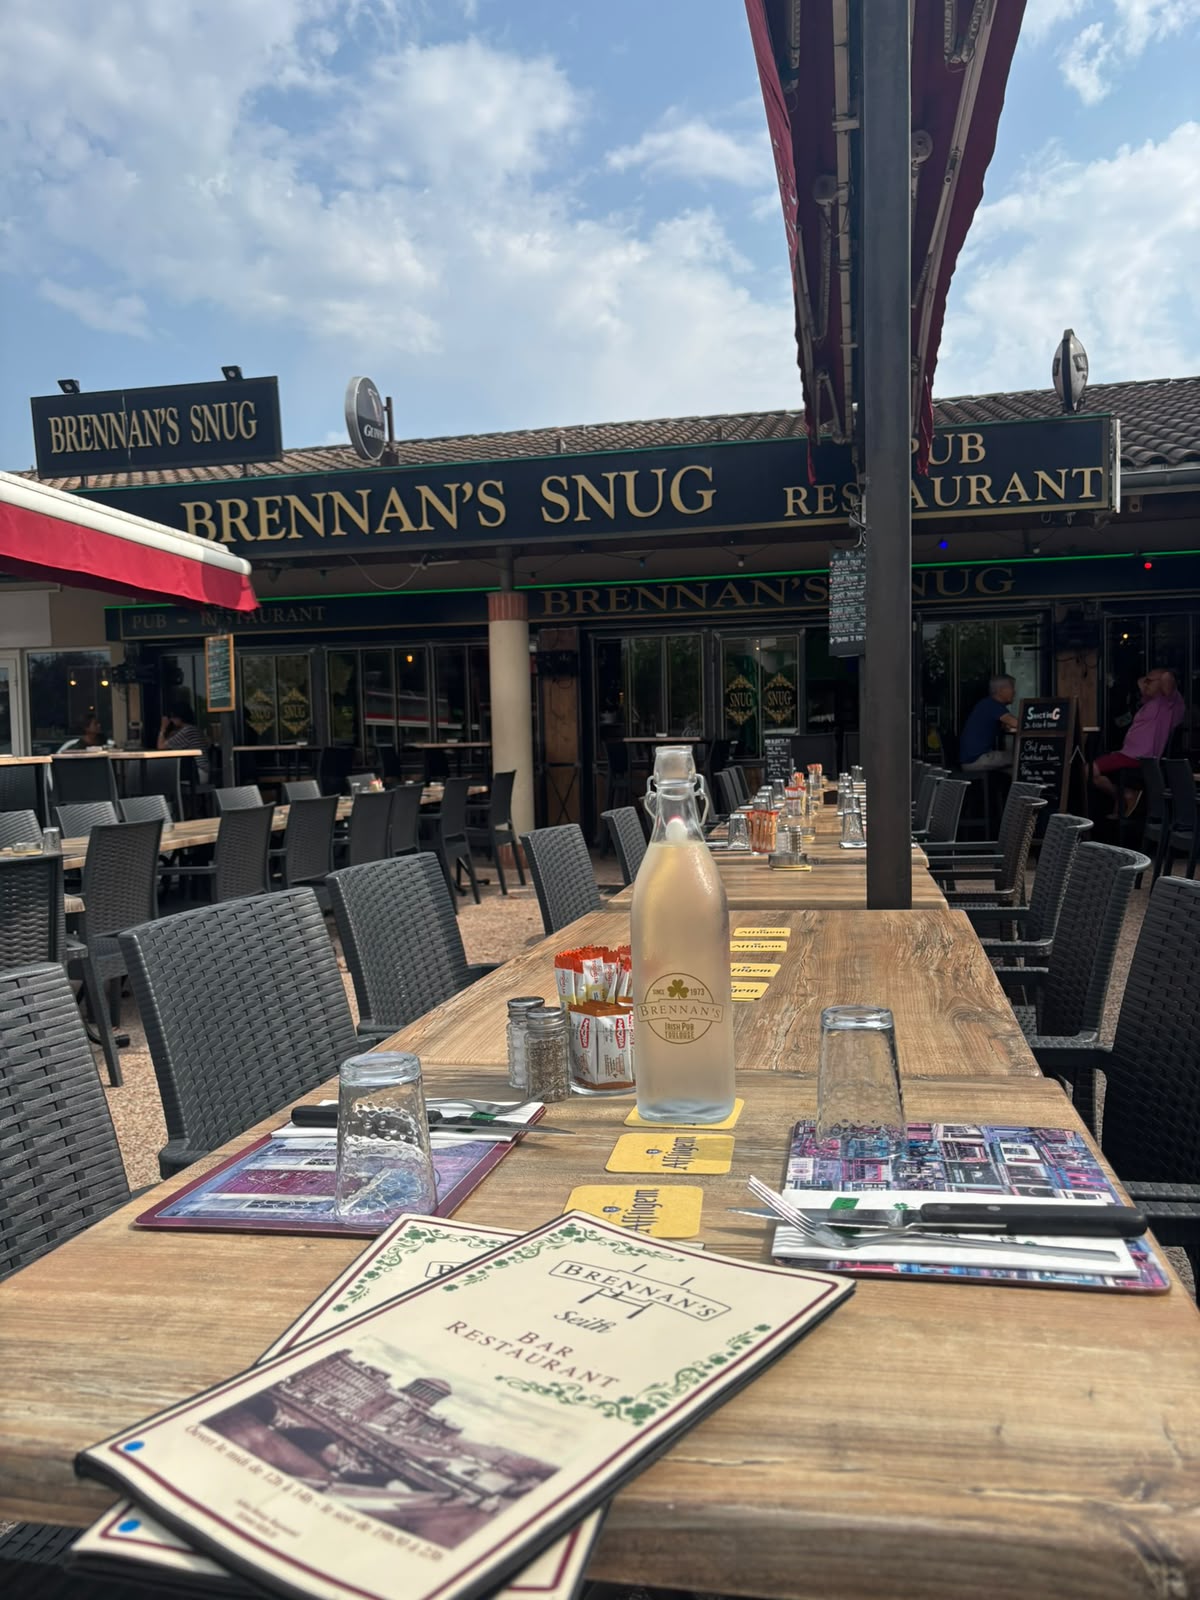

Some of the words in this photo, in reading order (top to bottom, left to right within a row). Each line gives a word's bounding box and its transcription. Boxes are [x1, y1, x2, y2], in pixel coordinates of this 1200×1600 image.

[48, 406, 180, 454] BRENNAN'S
[190, 400, 257, 443] SNUG
[180, 480, 506, 544] BRENNAN'S
[540, 464, 717, 524] SNUG
[783, 466, 1103, 517] RESAURANT
[541, 575, 829, 616] BRENNAN'S
[132, 614, 168, 629] PUB
[730, 692, 752, 707] SNUG
[768, 691, 792, 705] SNUG
[690, 988, 705, 996] 1973
[640, 1005, 721, 1018] BRENNAN'S
[664, 1031, 695, 1039] TOULOUSE
[661, 1136, 699, 1171] Affligem
[560, 1264, 717, 1318] BRENNAN'S
[444, 1320, 620, 1388] RESTAURANT
[515, 1331, 575, 1358] BAR
